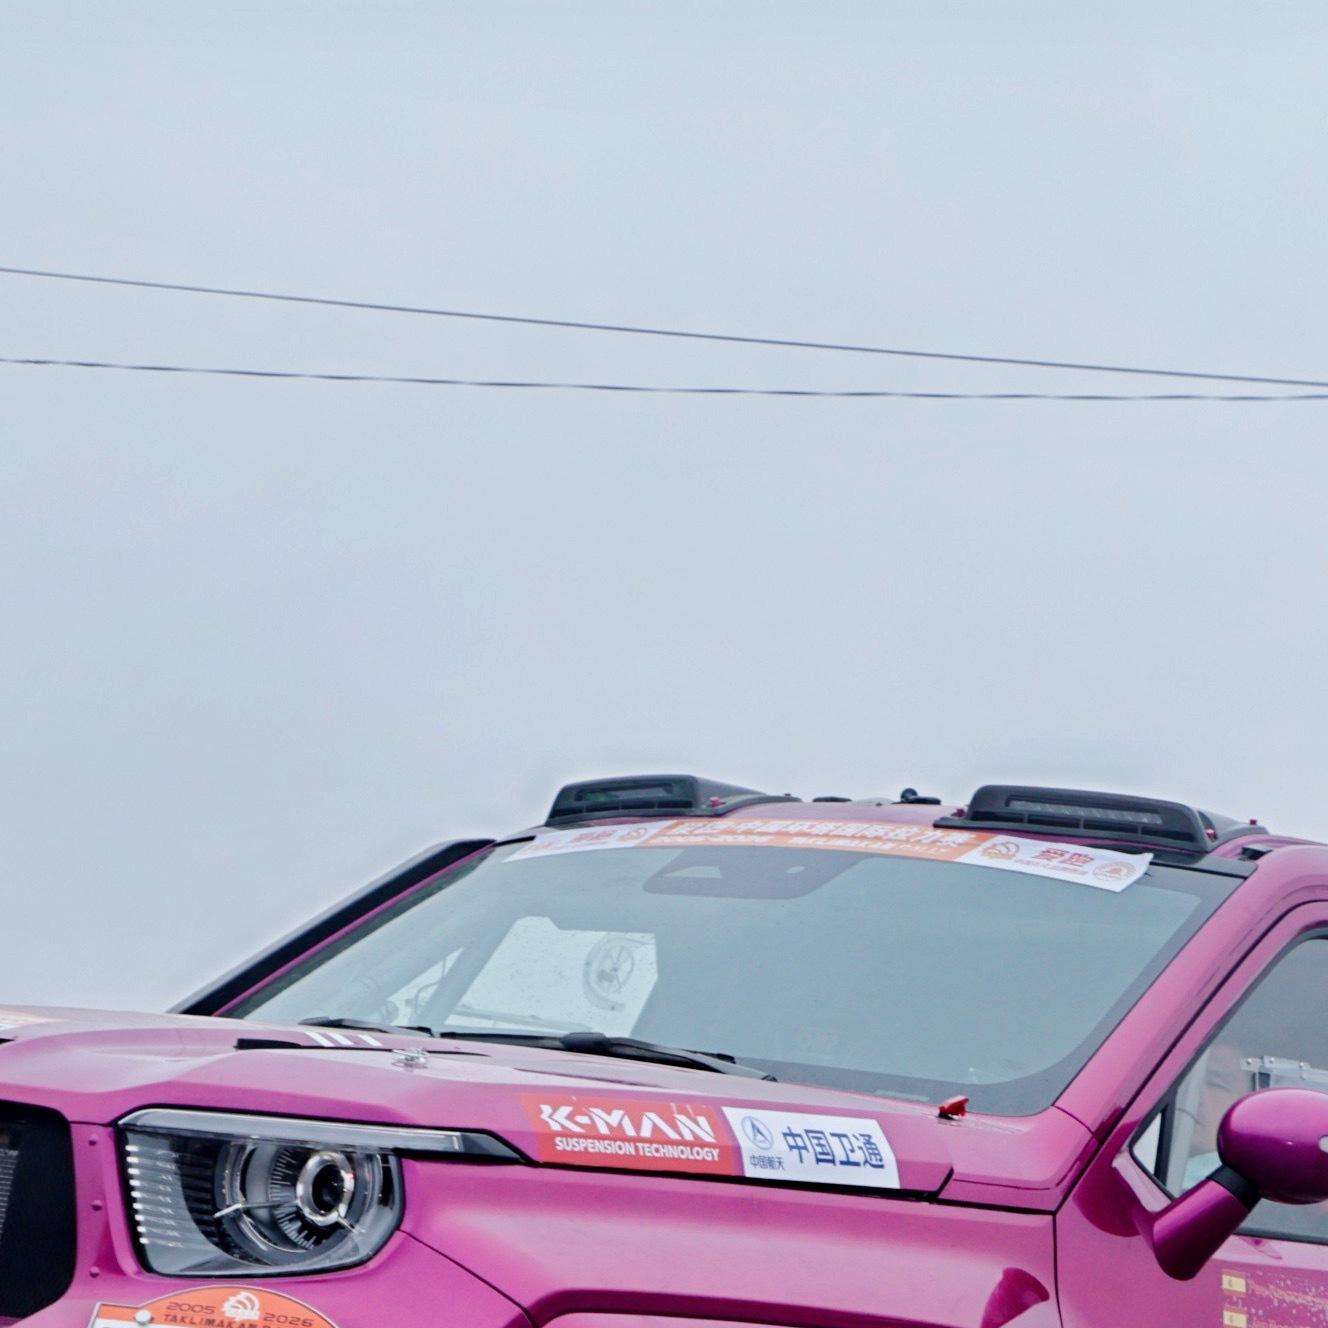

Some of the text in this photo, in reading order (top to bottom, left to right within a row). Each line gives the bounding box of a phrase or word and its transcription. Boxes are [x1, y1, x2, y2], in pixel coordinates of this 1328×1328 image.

[539, 1103, 717, 1143] K-MAN
[555, 1136, 720, 1162] SUSPENSION TECHNOLOGY
[782, 1125, 886, 1169] 中国卫通
[166, 1301, 313, 1328] 2005 2026
